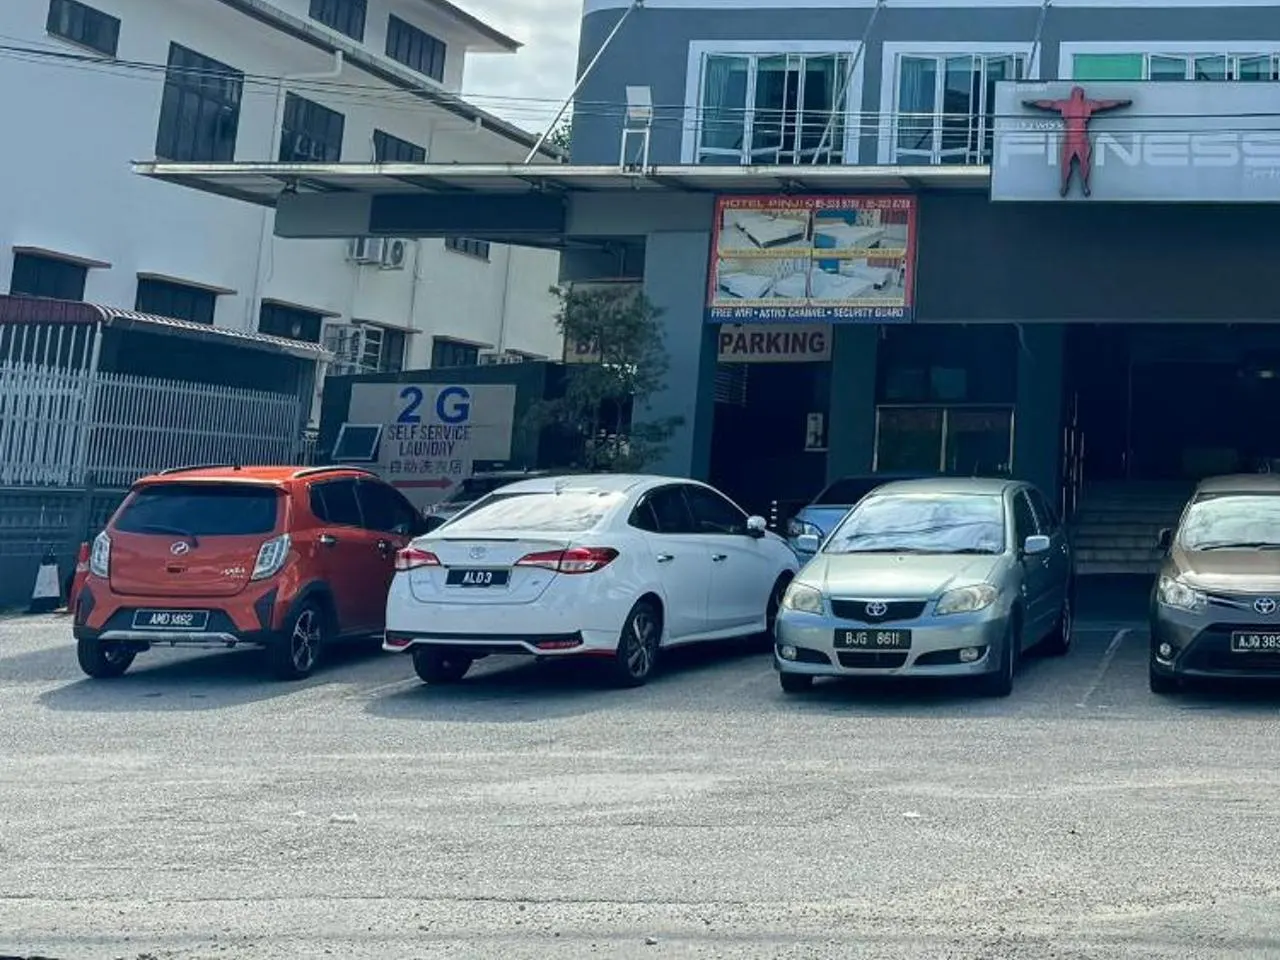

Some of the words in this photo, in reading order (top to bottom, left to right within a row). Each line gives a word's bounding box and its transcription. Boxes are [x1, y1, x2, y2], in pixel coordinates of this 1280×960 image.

[711, 308, 732, 317] FREE
[720, 332, 825, 354] PARKING
[387, 424, 419, 441] SELF
[420, 424, 472, 441] SERVICE
[399, 441, 455, 457] LAUNDRY
[845, 631, 868, 645] BJG
[876, 631, 900, 646] 8611
